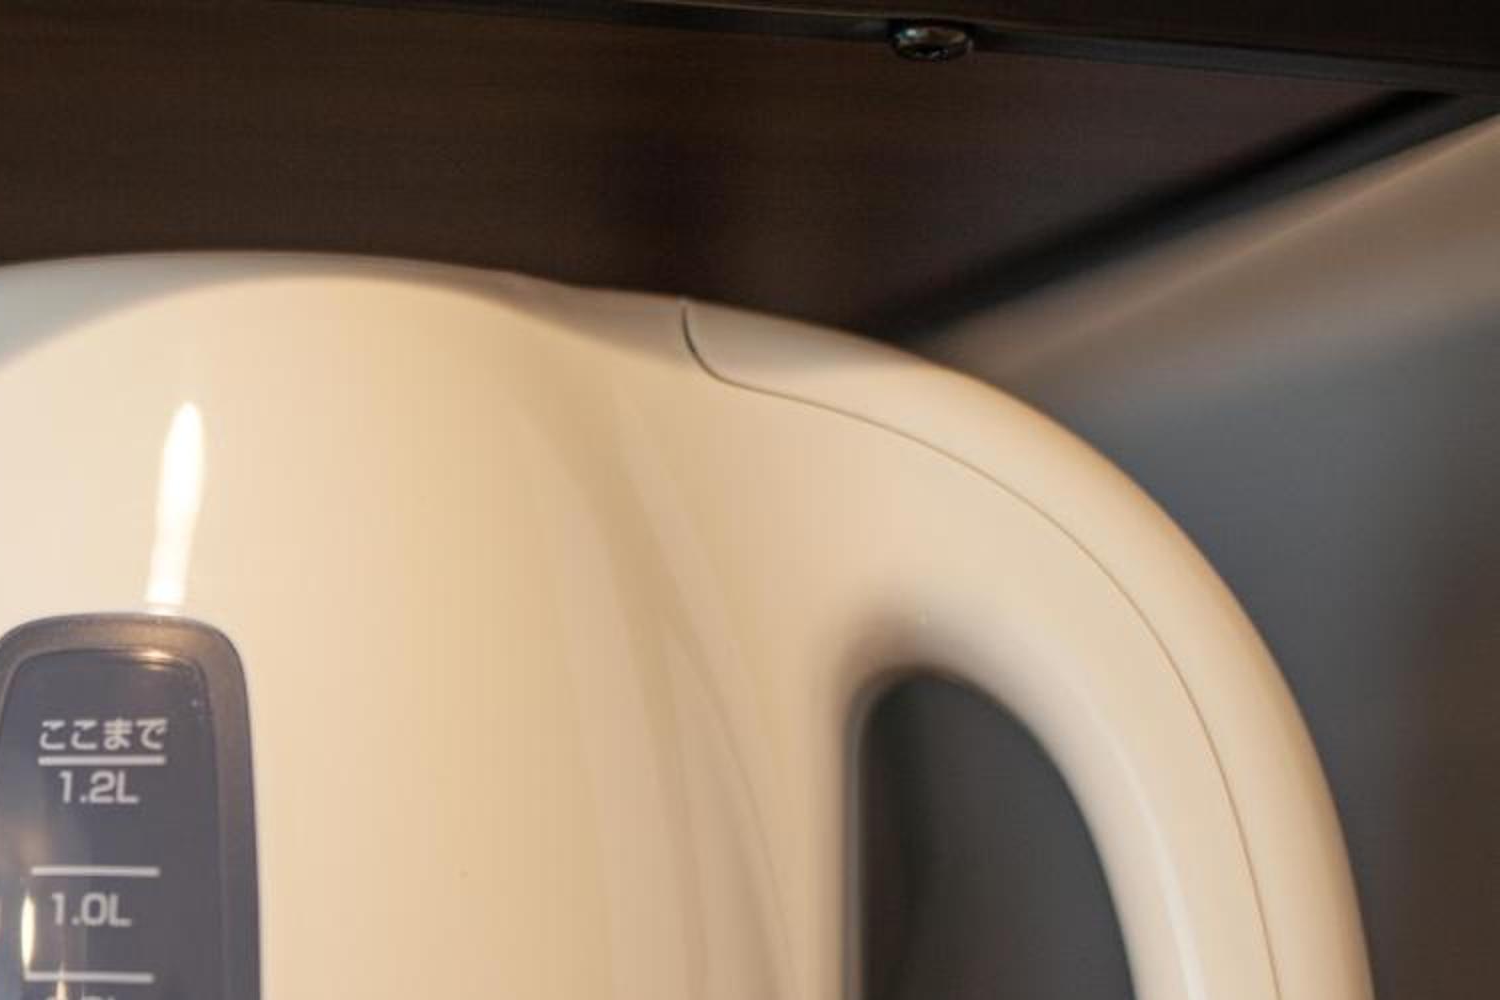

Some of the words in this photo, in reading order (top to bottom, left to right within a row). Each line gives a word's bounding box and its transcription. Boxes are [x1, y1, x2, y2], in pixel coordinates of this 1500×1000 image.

[38, 717, 168, 751] ここまで
[57, 770, 139, 804] 1.2L
[50, 892, 131, 927] 1.0L
